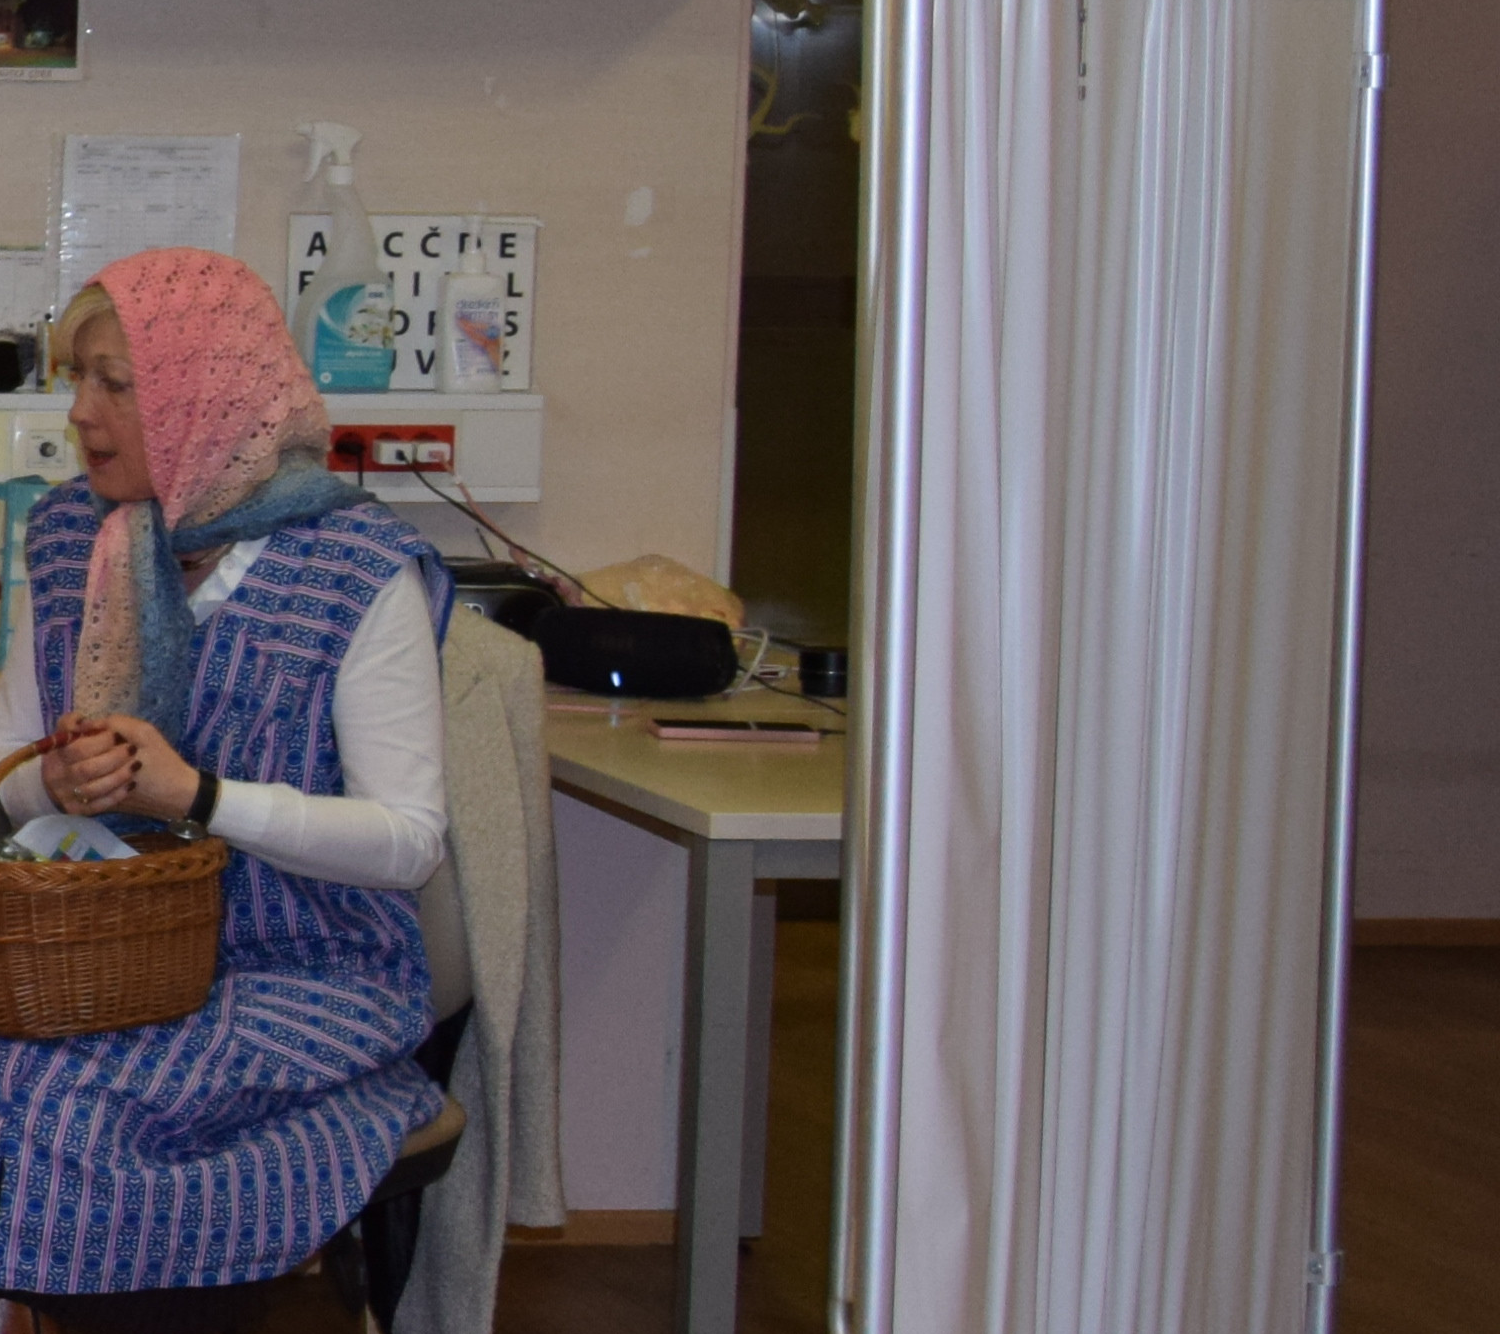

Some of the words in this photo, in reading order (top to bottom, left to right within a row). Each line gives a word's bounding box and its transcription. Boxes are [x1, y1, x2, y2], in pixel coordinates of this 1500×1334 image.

[306, 231, 327, 257] A
[383, 231, 404, 258] C
[420, 226, 441, 258] Č
[500, 232, 516, 258] E
[507, 272, 523, 298] L
[504, 310, 518, 337] S
[415, 349, 436, 375] V
